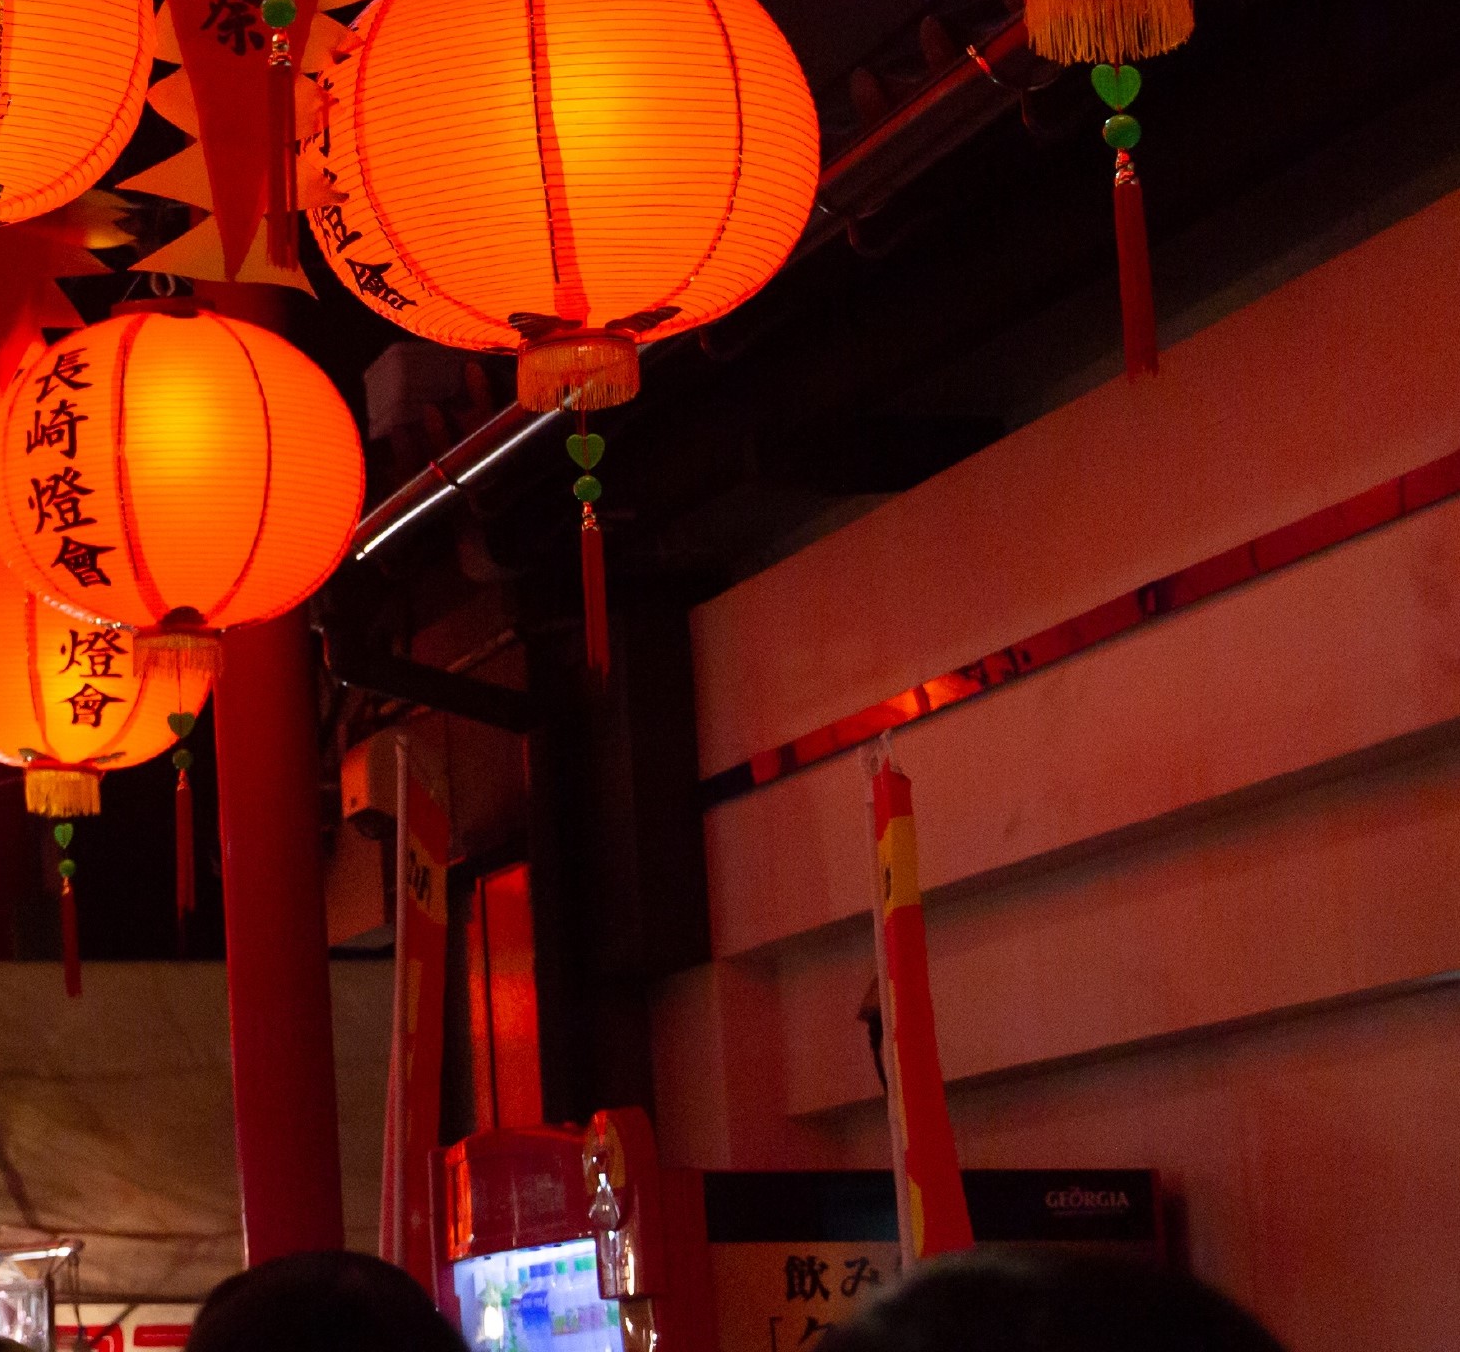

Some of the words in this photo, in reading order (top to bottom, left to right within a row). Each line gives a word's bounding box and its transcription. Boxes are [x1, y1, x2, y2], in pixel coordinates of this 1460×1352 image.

[26, 347, 117, 587] 長崎燈會
[58, 628, 130, 727] 燈會
[1045, 1187, 1129, 1208] GEORGIA
